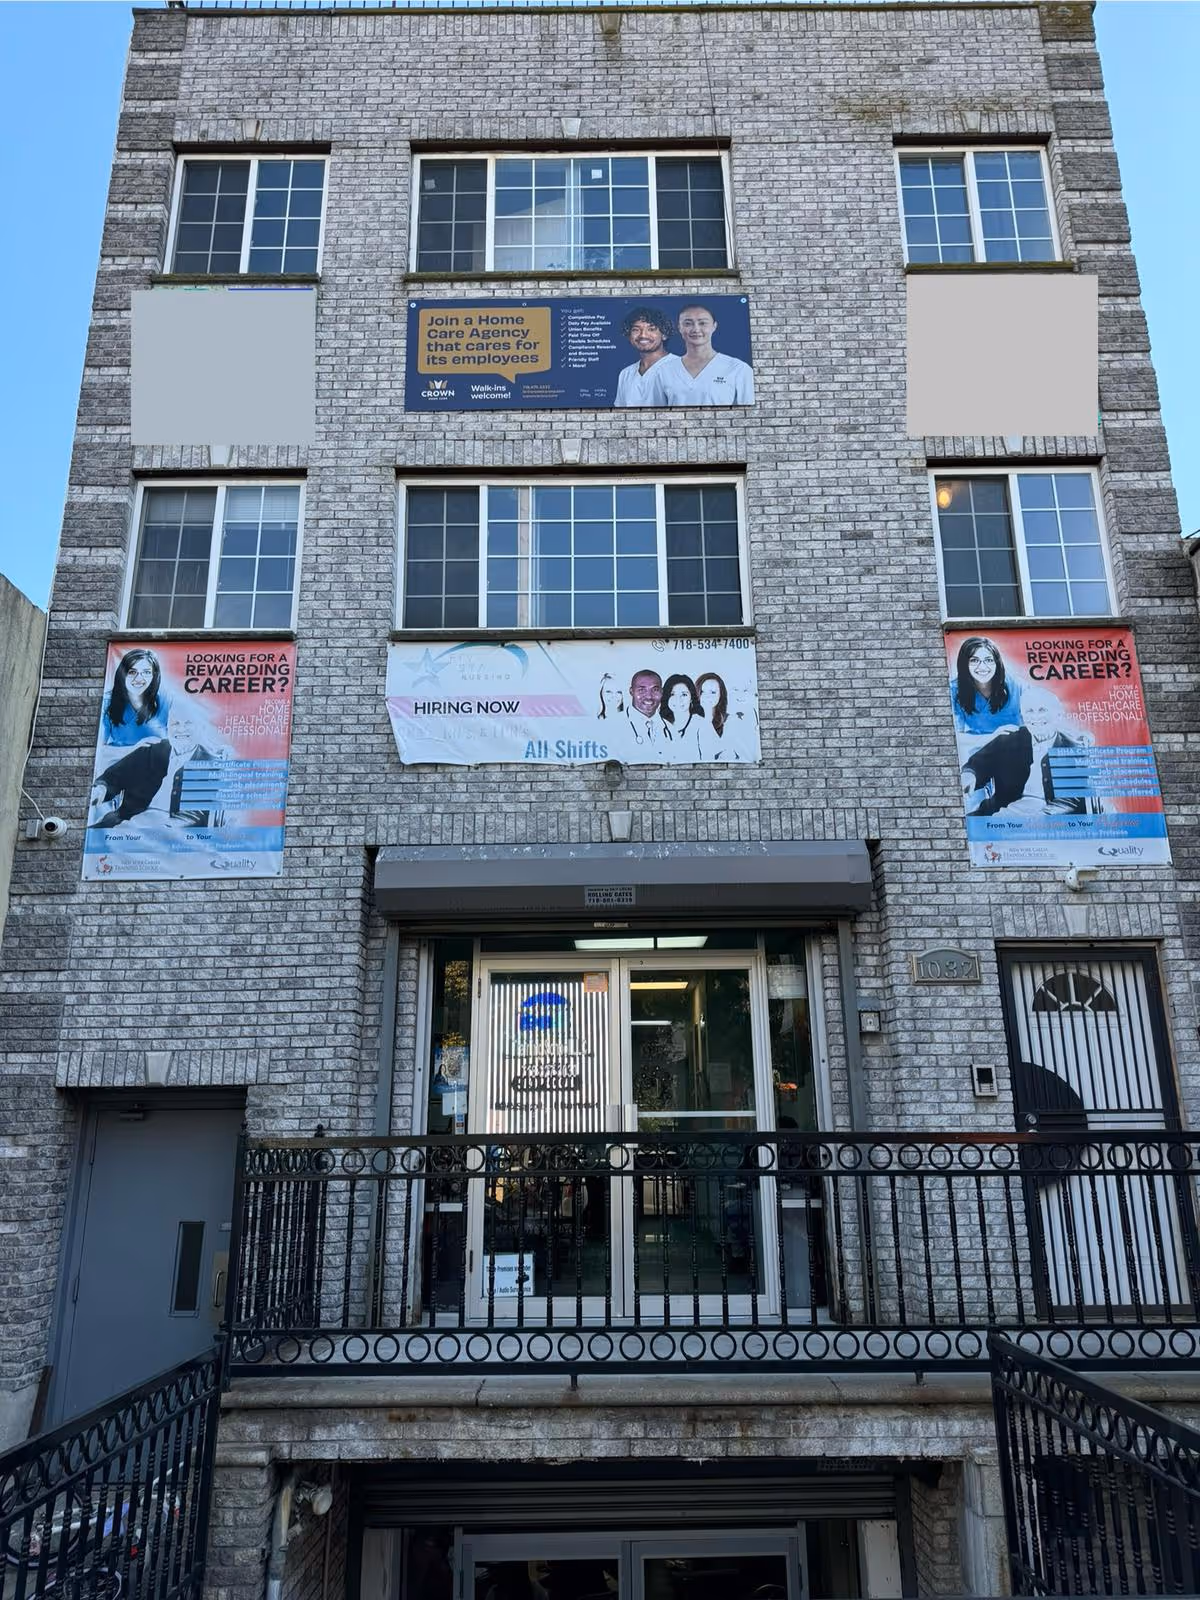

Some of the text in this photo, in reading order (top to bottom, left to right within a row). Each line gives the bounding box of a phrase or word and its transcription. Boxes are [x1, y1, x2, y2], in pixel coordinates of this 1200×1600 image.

[427, 315, 525, 326] Join a Home
[427, 328, 530, 340] Care Agency
[427, 339, 540, 352] that cares for
[426, 353, 539, 366] its employees
[421, 390, 455, 398] CROWN
[470, 384, 507, 392] Walk-ins
[470, 392, 511, 400] welcome!
[673, 638, 750, 650] 718-534-7400
[1025, 639, 1126, 650] LOOKING FOR A
[186, 653, 288, 663] LOOKING FOR A
[1027, 649, 1130, 664] REWARDING
[185, 664, 290, 676] REWARDING
[1029, 662, 1132, 681] CAREER?
[184, 677, 289, 694] CAREER?
[1109, 690, 1140, 700] HOME
[259, 704, 290, 714] HOME
[414, 700, 521, 715] HIRING NOW
[1078, 700, 1142, 712] HEALTHCARE
[225, 715, 289, 726] HEALTHCARE
[1066, 711, 1144, 722] PROFESSIONAL!
[525, 739, 609, 759] All Shifts
[1116, 747, 1147, 755] Program
[255, 771, 283, 779] training
[229, 781, 243, 789] Job
[1098, 845, 1144, 857] Quality
[210, 858, 257, 871] Quality
[917, 960, 975, 978] 1032
